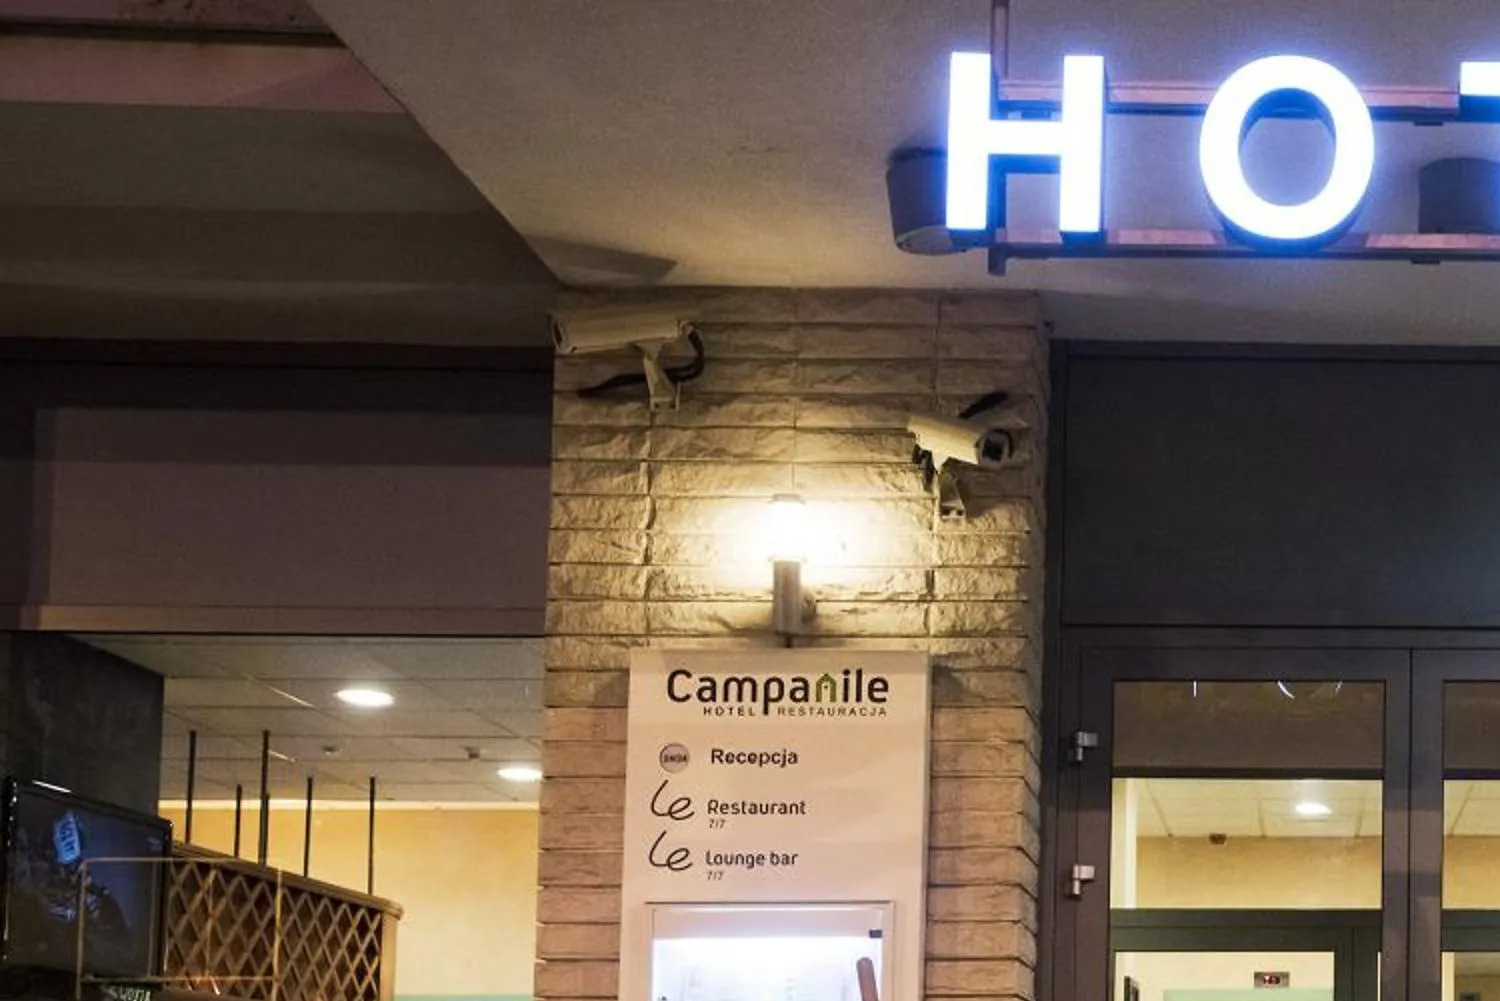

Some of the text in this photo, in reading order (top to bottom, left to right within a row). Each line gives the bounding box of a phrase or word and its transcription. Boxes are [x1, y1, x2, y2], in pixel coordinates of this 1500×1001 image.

[667, 669, 889, 715] Campanile
[703, 705, 887, 717] HOTEL RESTAURACJA
[711, 749, 798, 768] Recepcja
[707, 799, 806, 815] Restaurant
[705, 851, 765, 869] Lounge
[770, 850, 799, 866] bar
